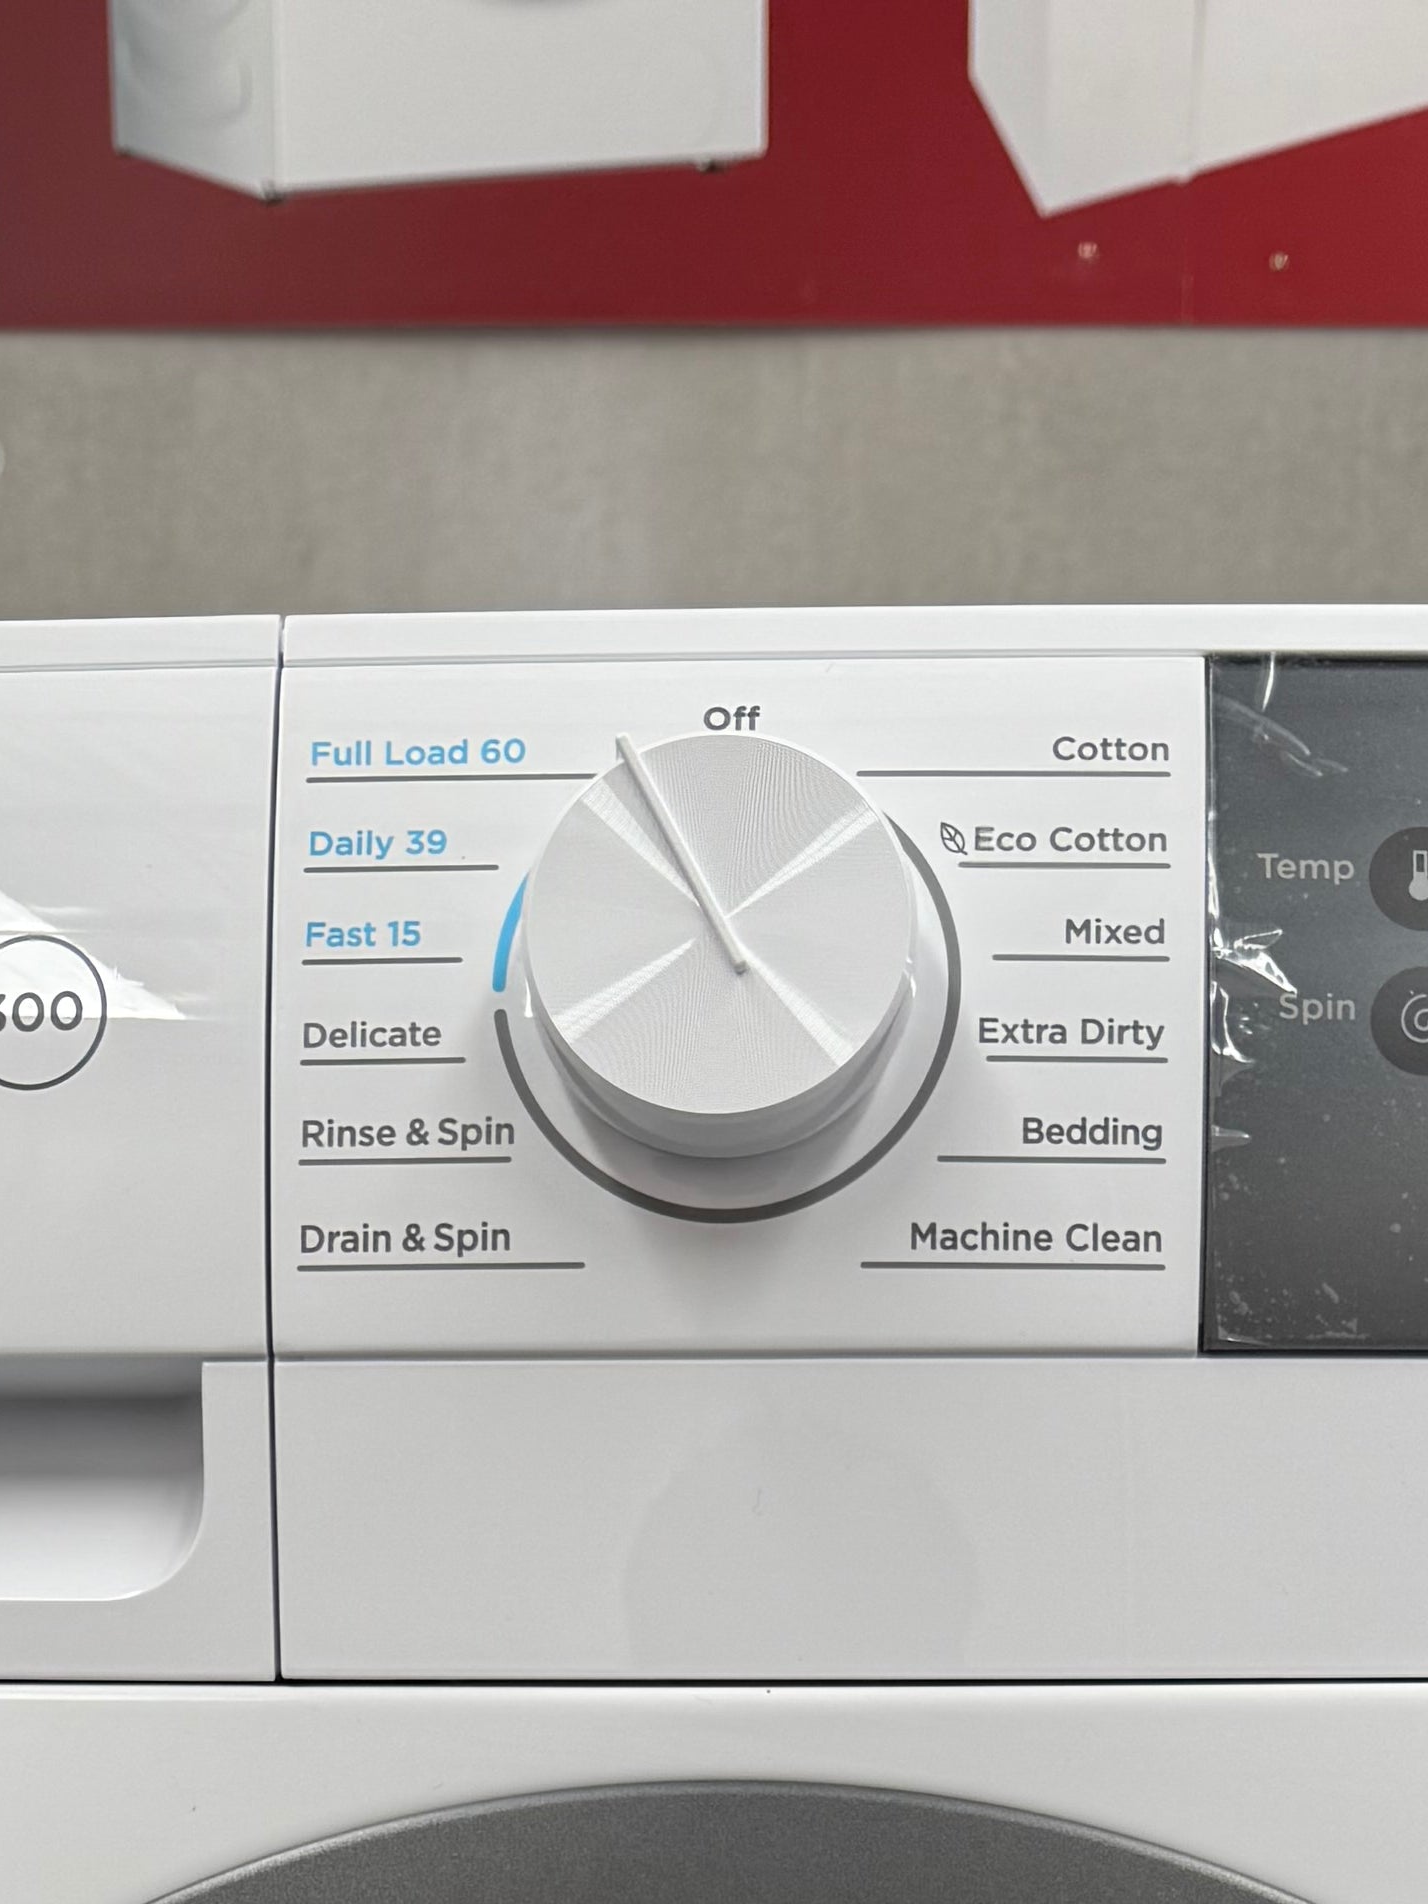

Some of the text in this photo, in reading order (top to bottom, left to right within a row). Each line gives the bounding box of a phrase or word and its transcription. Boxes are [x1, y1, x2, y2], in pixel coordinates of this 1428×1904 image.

[703, 706, 760, 732] Off
[311, 739, 526, 768] Full Load 60
[1052, 735, 1170, 762] Cotton
[309, 829, 447, 860] Daily 39
[974, 825, 1168, 853] Eco Cotton
[1258, 852, 1355, 885] Temp
[305, 921, 421, 948] Fast 15
[1066, 917, 1166, 946] Mixed
[1278, 994, 1356, 1024] Spin
[302, 1021, 442, 1048] Delicate
[978, 1016, 1165, 1052] Extra Dirty
[301, 1116, 516, 1153] Rinse & Spin
[1022, 1117, 1164, 1154] Bedding
[299, 1221, 511, 1258] Drain & Spin
[911, 1222, 1162, 1252] Machine Clean
